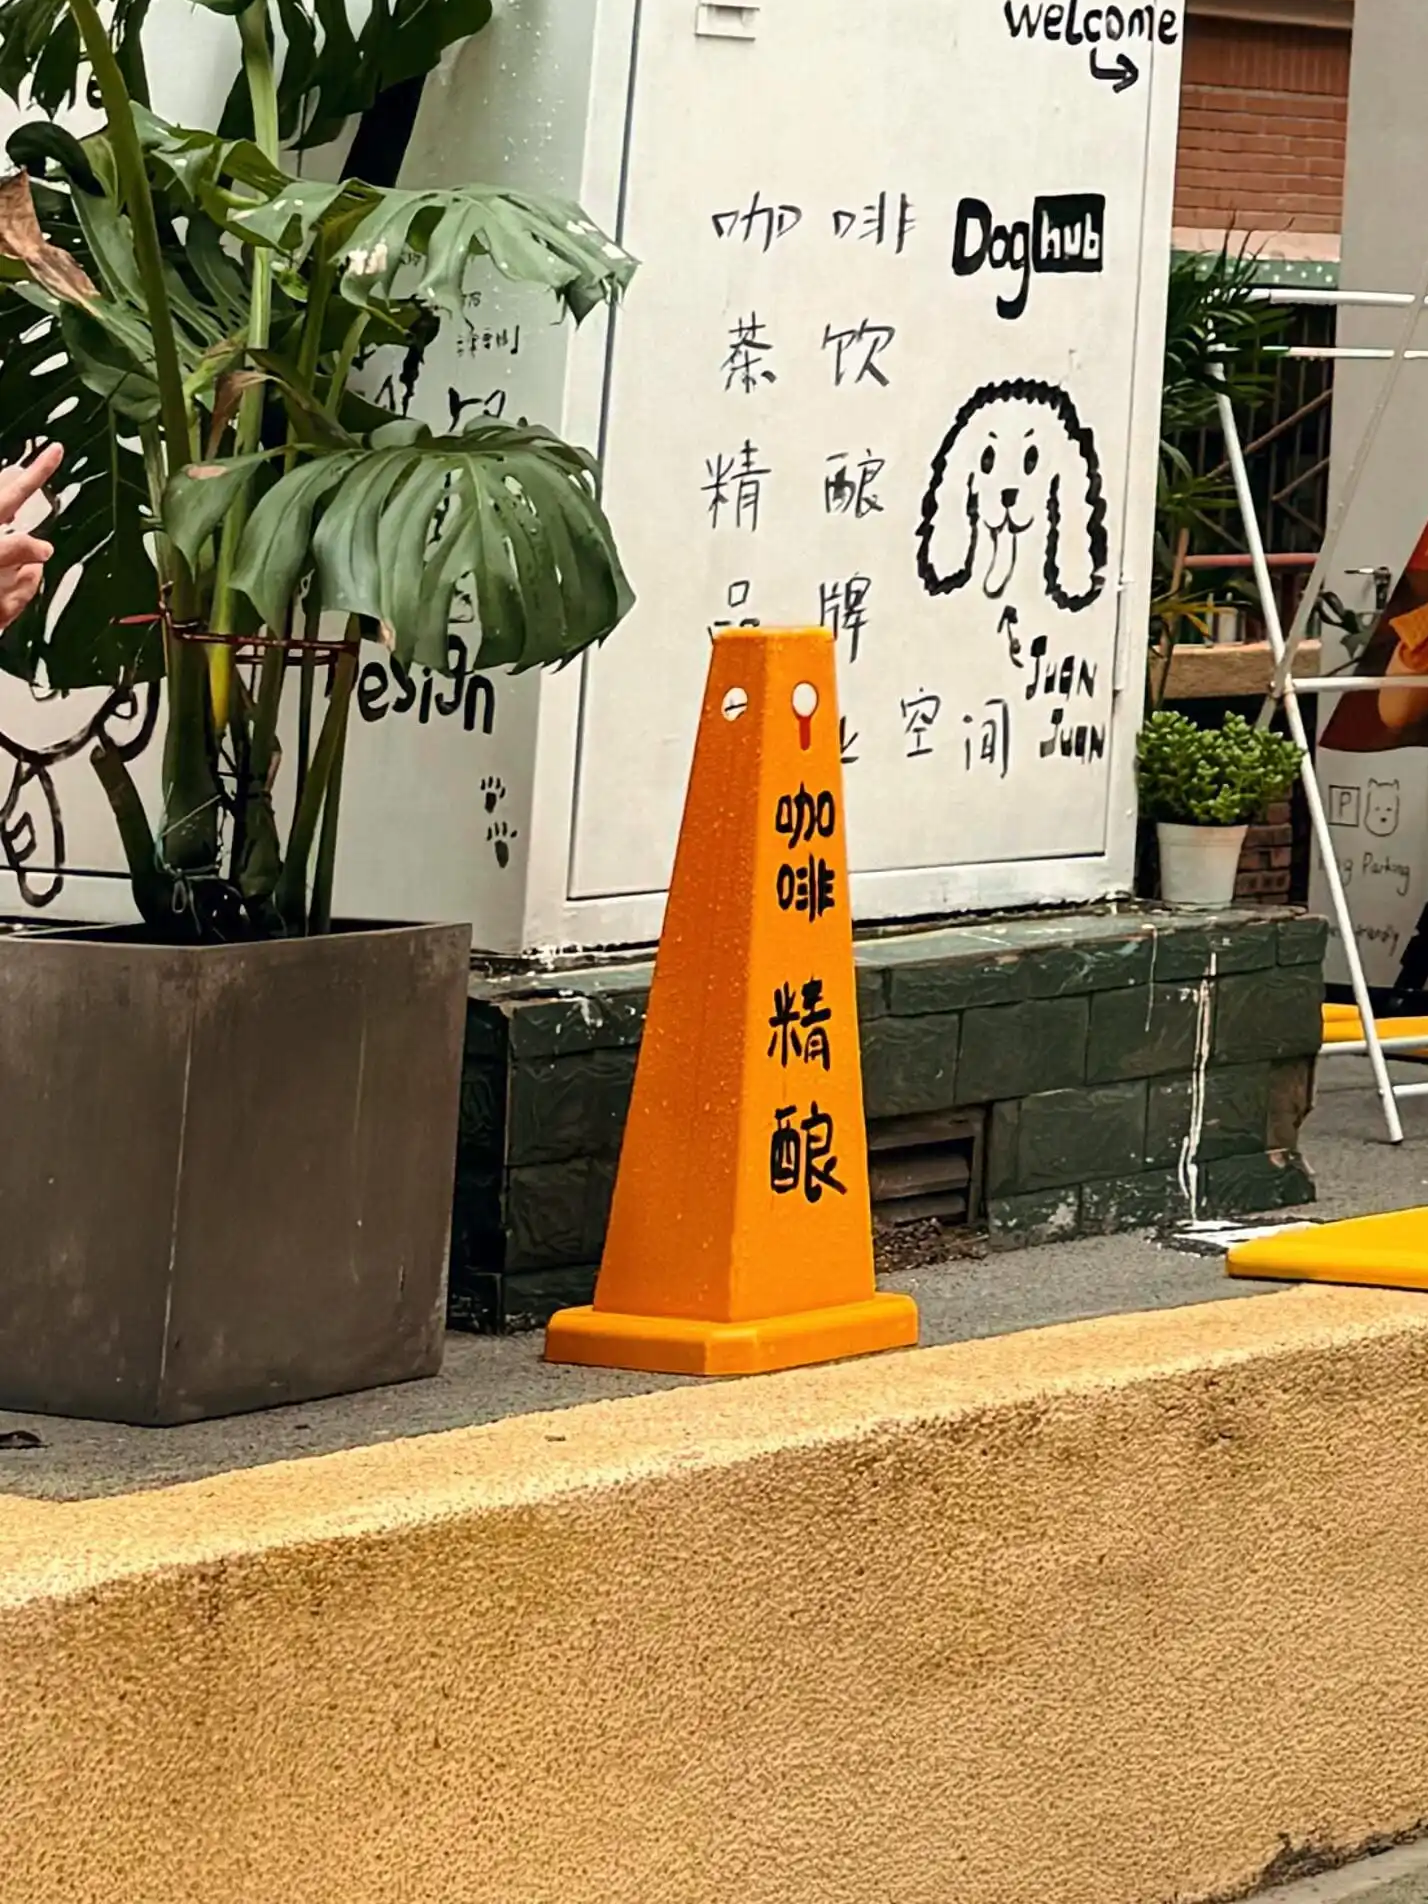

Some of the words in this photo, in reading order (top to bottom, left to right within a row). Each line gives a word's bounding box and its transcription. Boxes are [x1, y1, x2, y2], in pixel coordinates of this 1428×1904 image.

[711, 190, 916, 254] 咖啡
[721, 311, 896, 394] 茶饮
[700, 439, 886, 533] 精酿
[325, 633, 496, 736] esign
[773, 782, 836, 923] 咖啡
[765, 979, 848, 1204] 精酿
